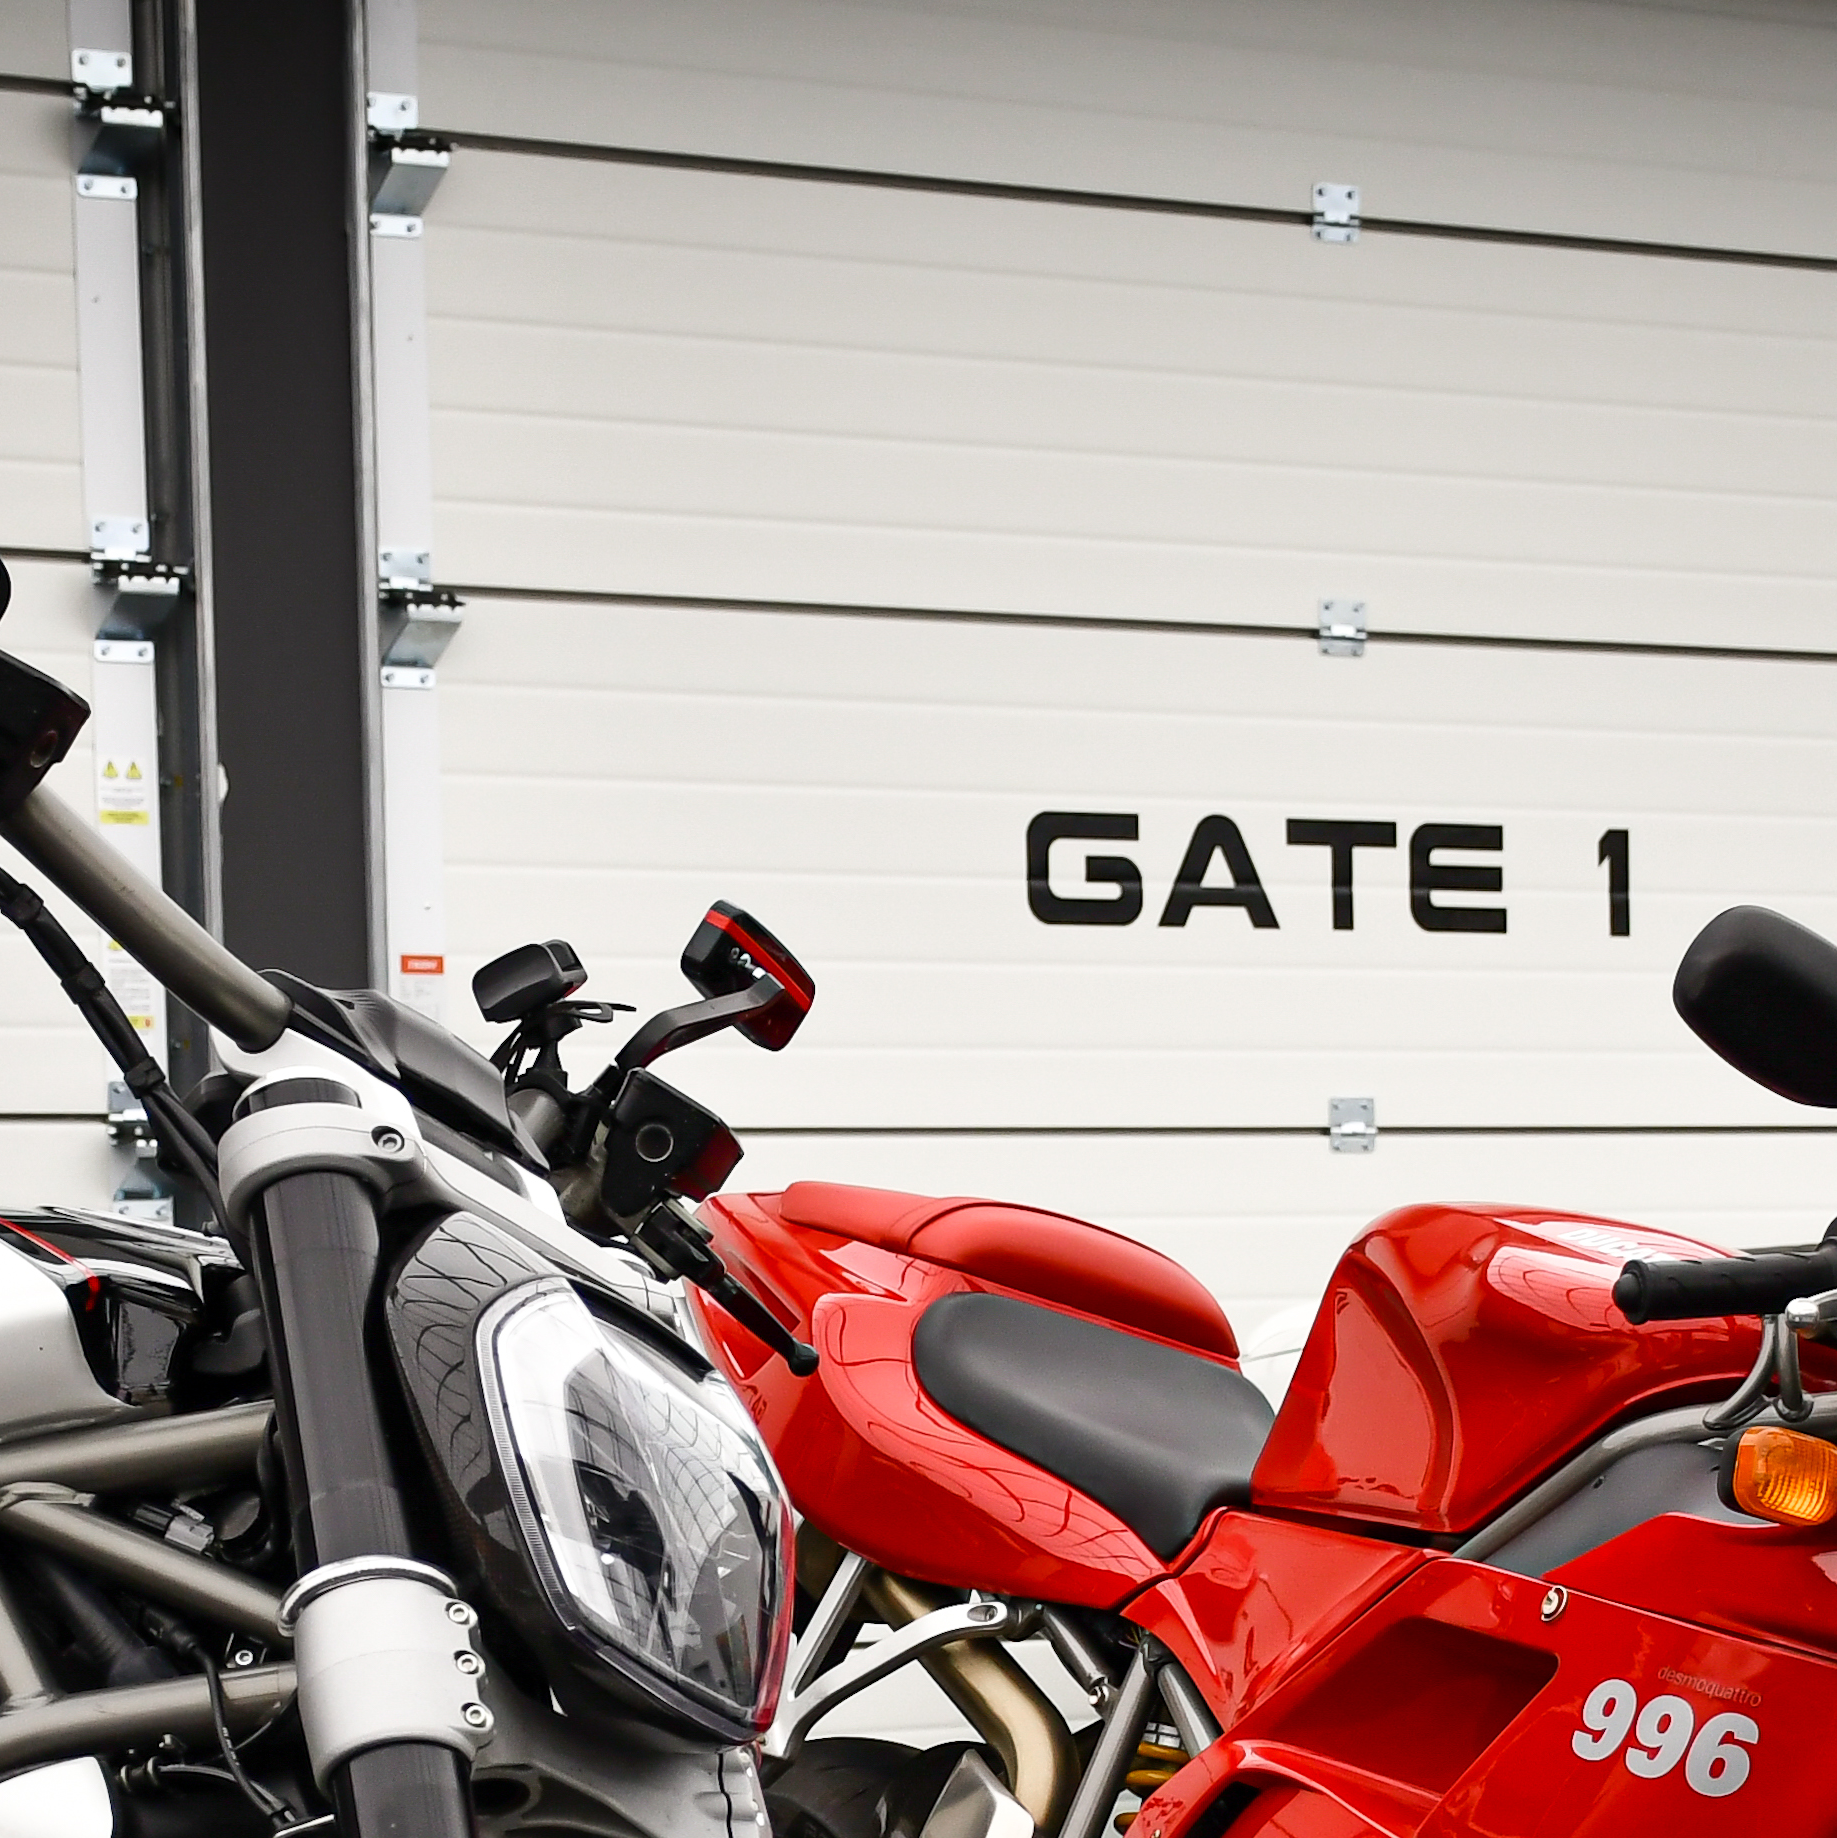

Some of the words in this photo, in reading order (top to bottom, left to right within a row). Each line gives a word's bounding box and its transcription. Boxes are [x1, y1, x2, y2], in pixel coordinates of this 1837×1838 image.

[1027, 811, 1507, 934] GATE
[1598, 829, 1630, 936] 1
[1571, 1678, 1760, 1797] 996
[1656, 1664, 1762, 1708] desmoquattro
